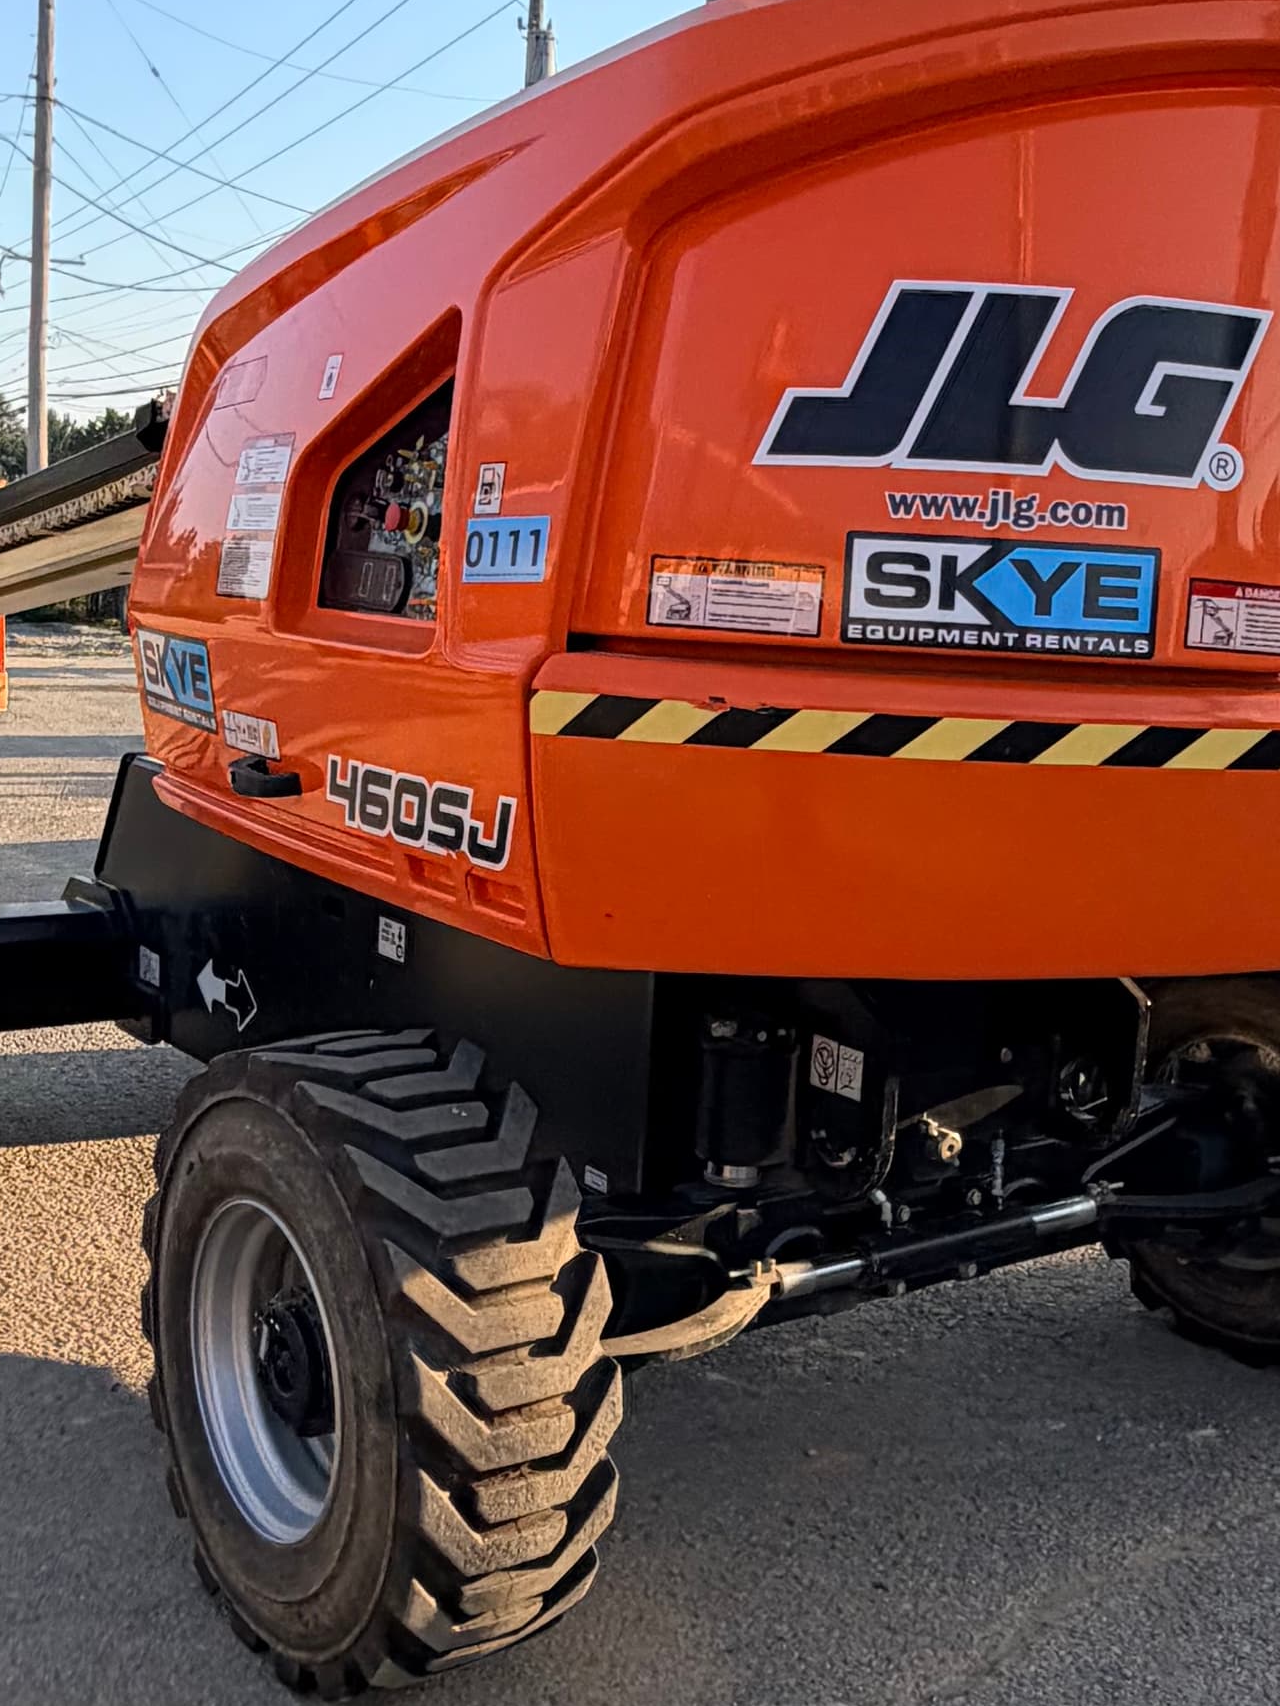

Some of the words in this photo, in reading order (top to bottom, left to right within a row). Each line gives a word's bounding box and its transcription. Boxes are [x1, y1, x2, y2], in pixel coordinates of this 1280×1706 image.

[887, 490, 1127, 529] www.jlg.com
[465, 529, 542, 568] 0111
[863, 543, 1142, 623] SKYE
[847, 625, 1019, 647] EQUIPMENT
[1026, 635, 1150, 654] RENTALS
[142, 638, 210, 702] SKYE
[328, 756, 515, 868] 460SJ
